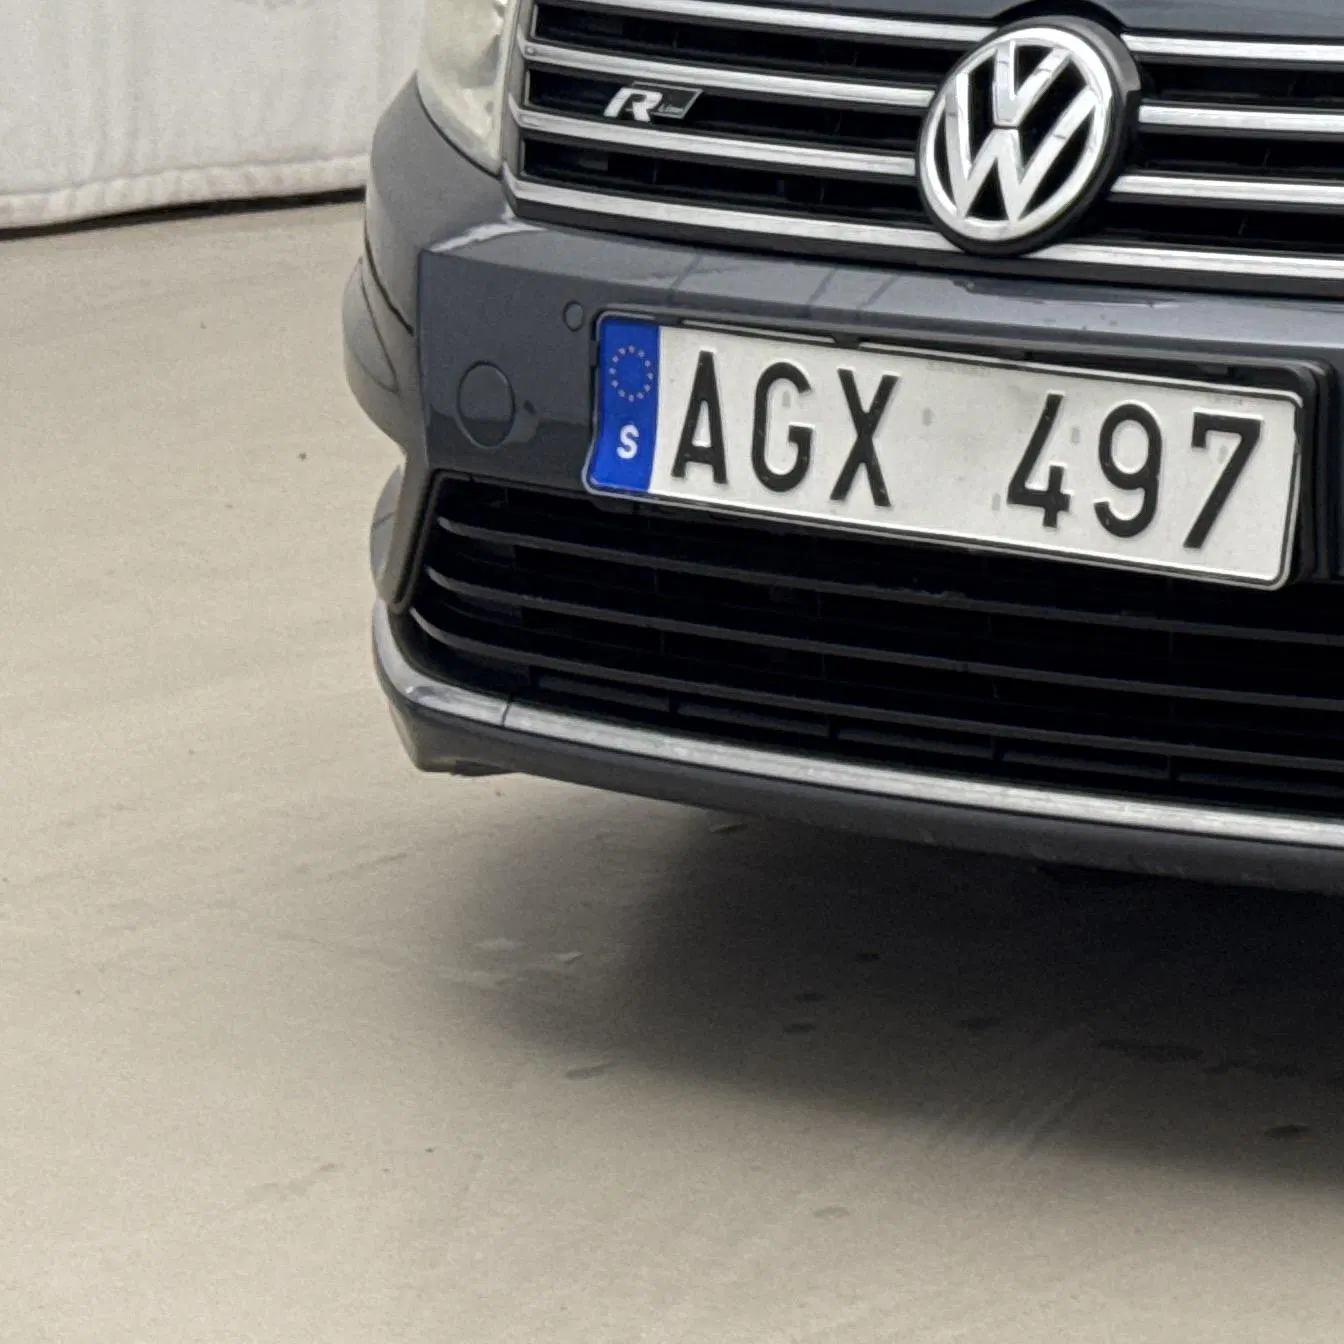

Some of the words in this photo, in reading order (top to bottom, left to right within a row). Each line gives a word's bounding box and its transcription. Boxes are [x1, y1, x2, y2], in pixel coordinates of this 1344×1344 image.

[616, 423, 640, 460] S
[670, 350, 899, 509] AGX
[1006, 393, 1262, 550] 497
